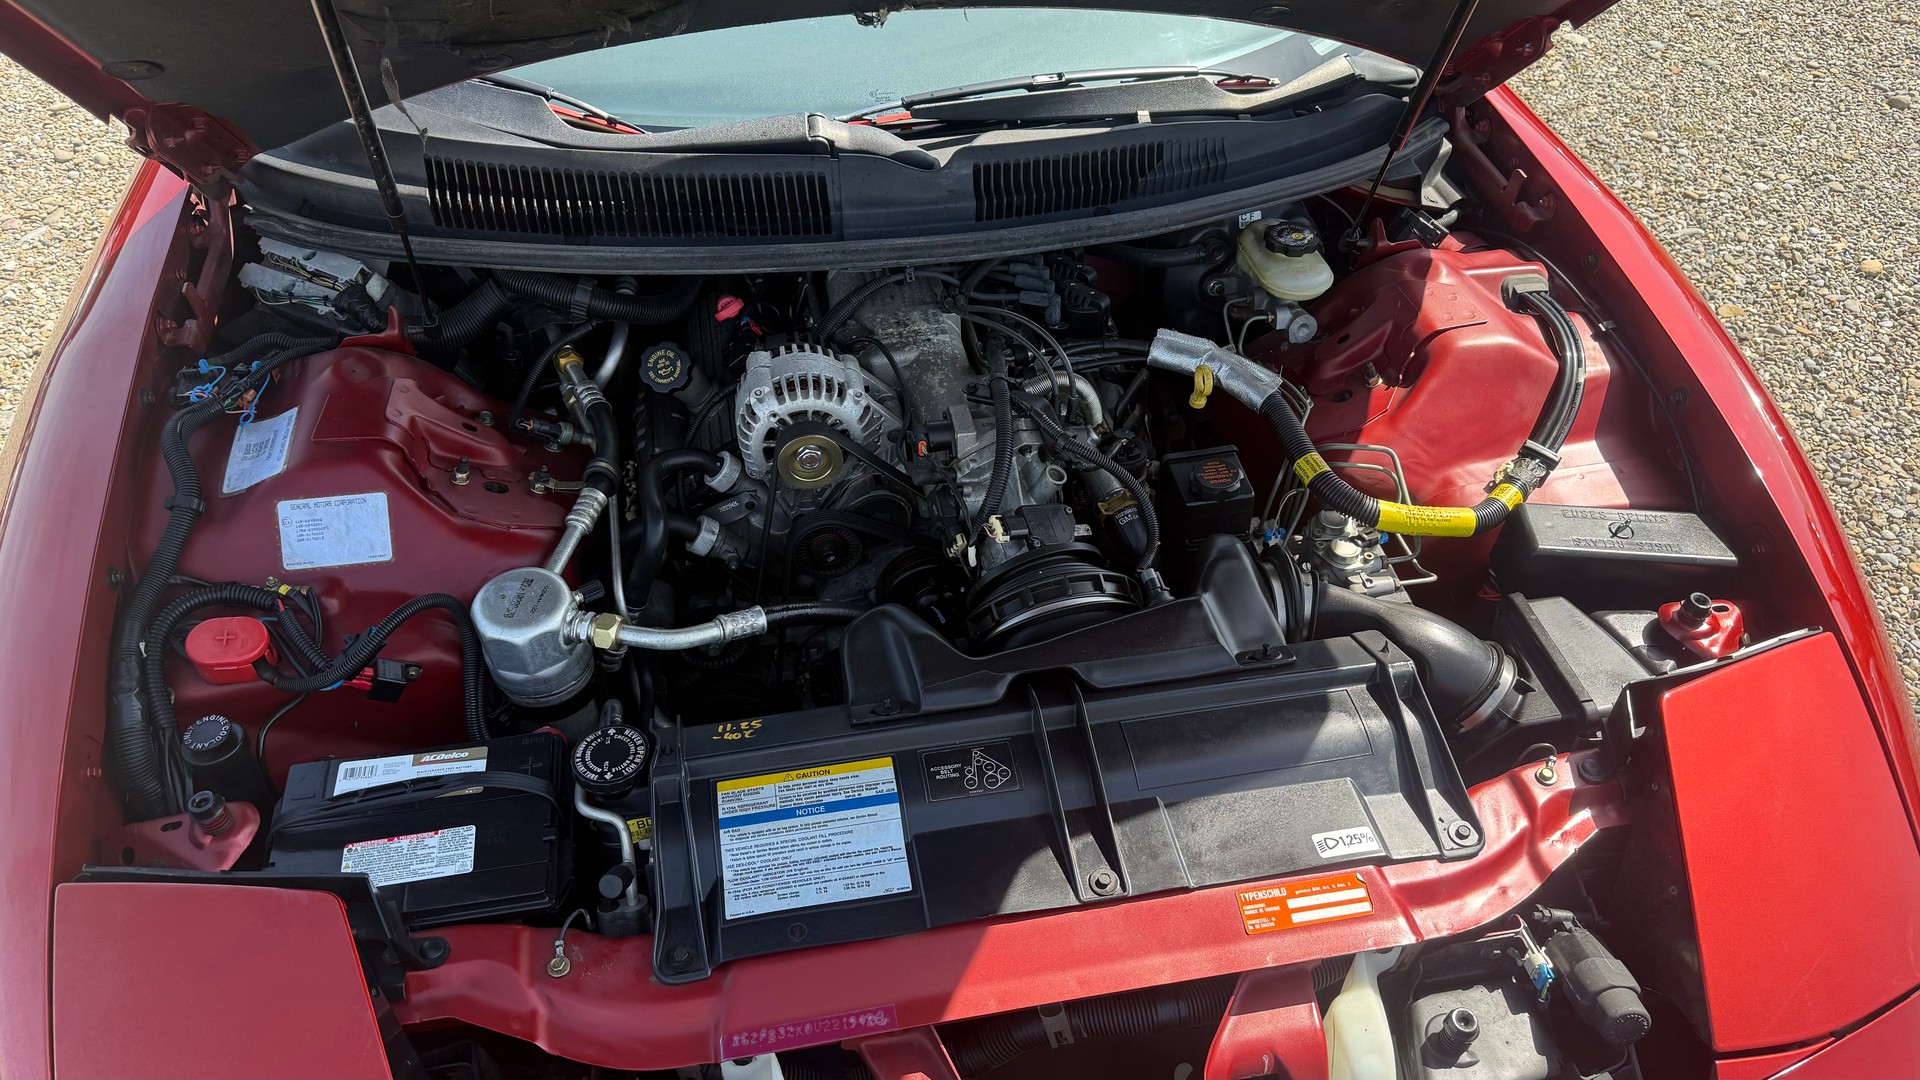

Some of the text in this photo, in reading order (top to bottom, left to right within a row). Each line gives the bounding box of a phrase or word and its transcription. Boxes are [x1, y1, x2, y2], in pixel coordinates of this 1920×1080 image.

[648, 350, 665, 367] ENGINE
[290, 502, 311, 510] GENERAL
[334, 498, 367, 507] CORPORATION
[1119, 514, 1133, 525] GM
[1560, 509, 1668, 522] FUSES RELAYS
[1572, 538, 1683, 553] FUSES RELAYS
[184, 715, 229, 748] ENGINE COOLANT ONLY
[718, 719, 762, 732] 11.25
[586, 730, 602, 741] ALIGN
[614, 734, 629, 743] CHECK
[576, 741, 588, 757] ARROW
[622, 729, 644, 775] NEVER OPEN HOT
[420, 752, 469, 762] ACDelco
[576, 762, 586, 773] VENT
[612, 760, 630, 772] BOTTLE
[930, 763, 962, 772] ACCESSORY
[583, 770, 599, 780] TUBE
[796, 769, 830, 779] CAUTION
[796, 806, 825, 816] NOTICE
[1339, 832, 1374, 848] 1,25%
[1240, 887, 1287, 902] TYPENSCHILD
